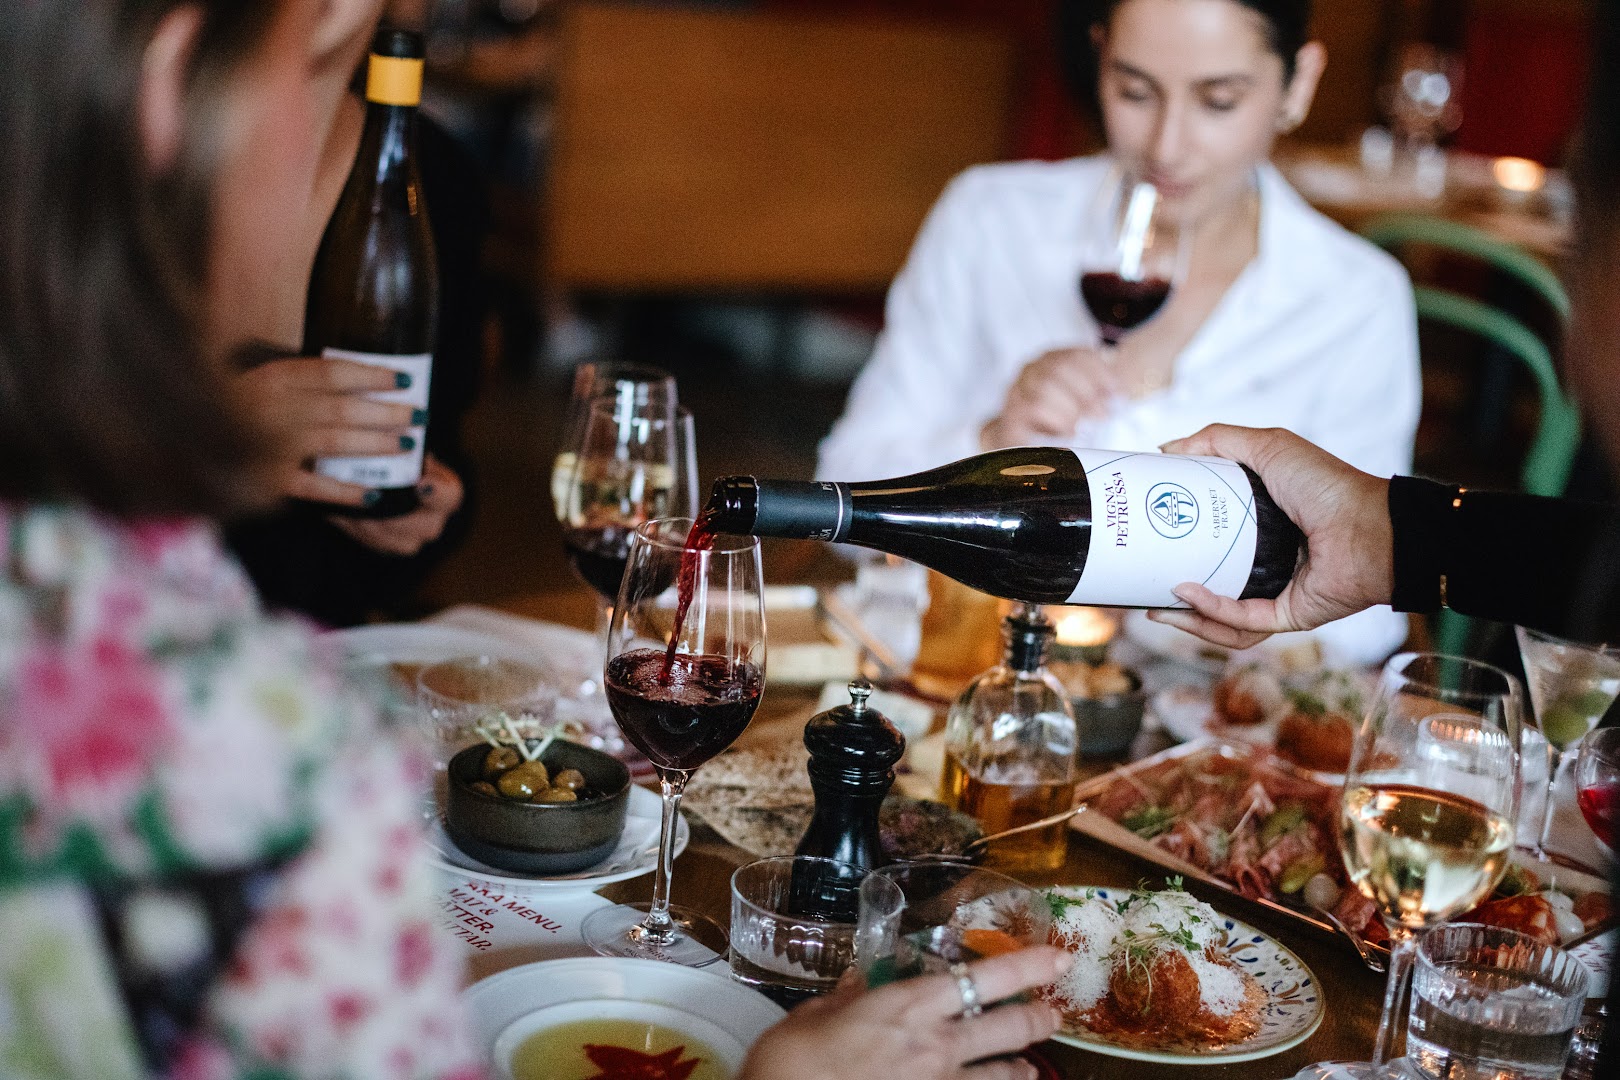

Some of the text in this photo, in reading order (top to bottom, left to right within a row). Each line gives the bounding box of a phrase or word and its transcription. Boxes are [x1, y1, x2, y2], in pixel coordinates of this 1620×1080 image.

[1105, 486, 1116, 528] VIGNA
[1112, 472, 1129, 547] PETRUSSA
[1209, 488, 1221, 538] CABERNET
[1219, 497, 1229, 528] FRANC
[502, 901, 563, 933] MENU.
